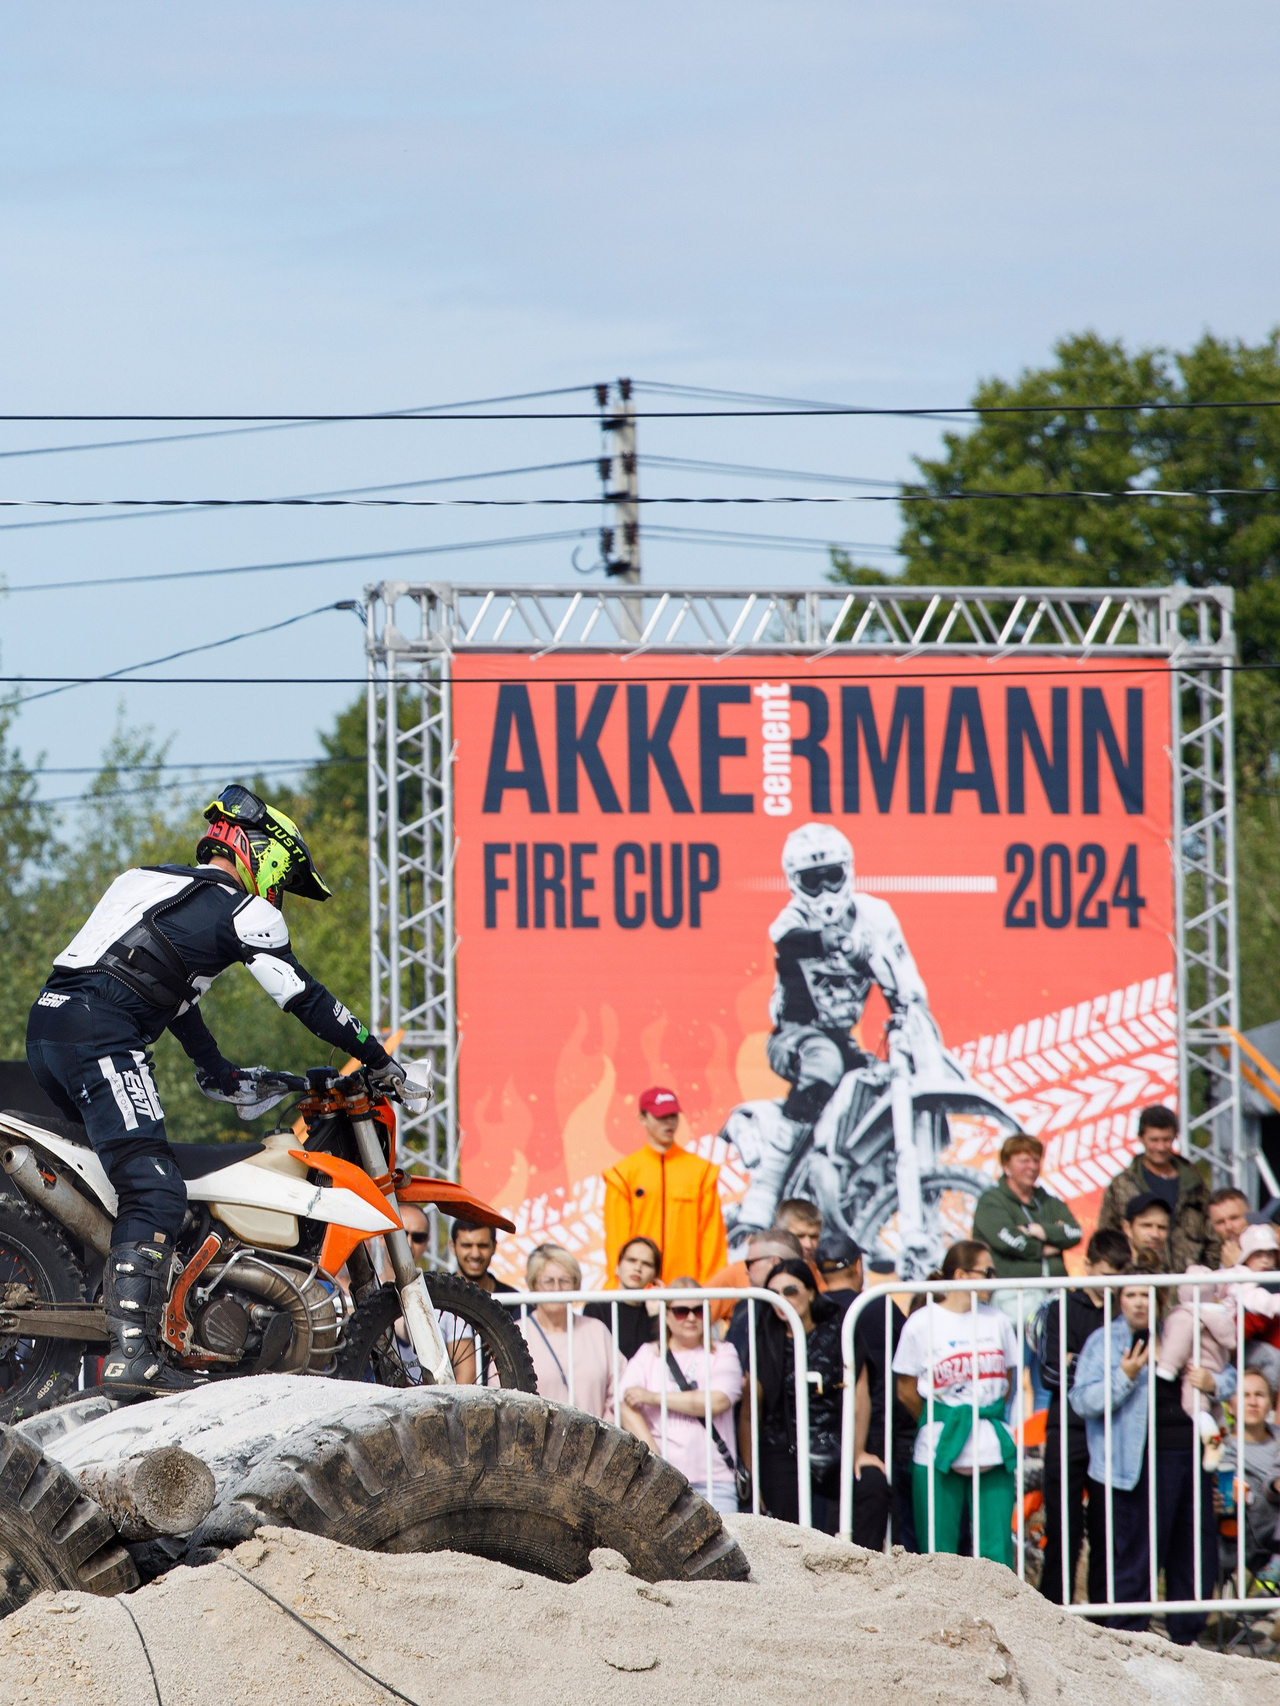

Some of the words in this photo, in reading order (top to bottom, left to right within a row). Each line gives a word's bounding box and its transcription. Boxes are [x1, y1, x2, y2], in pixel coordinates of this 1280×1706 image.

[483, 684, 1145, 814] AKKERMANN
[755, 682, 791, 817] cement
[265, 823, 307, 863] JUST1
[484, 843, 600, 929] FIRE
[613, 843, 720, 929] CUP
[1004, 843, 1146, 929] 2024
